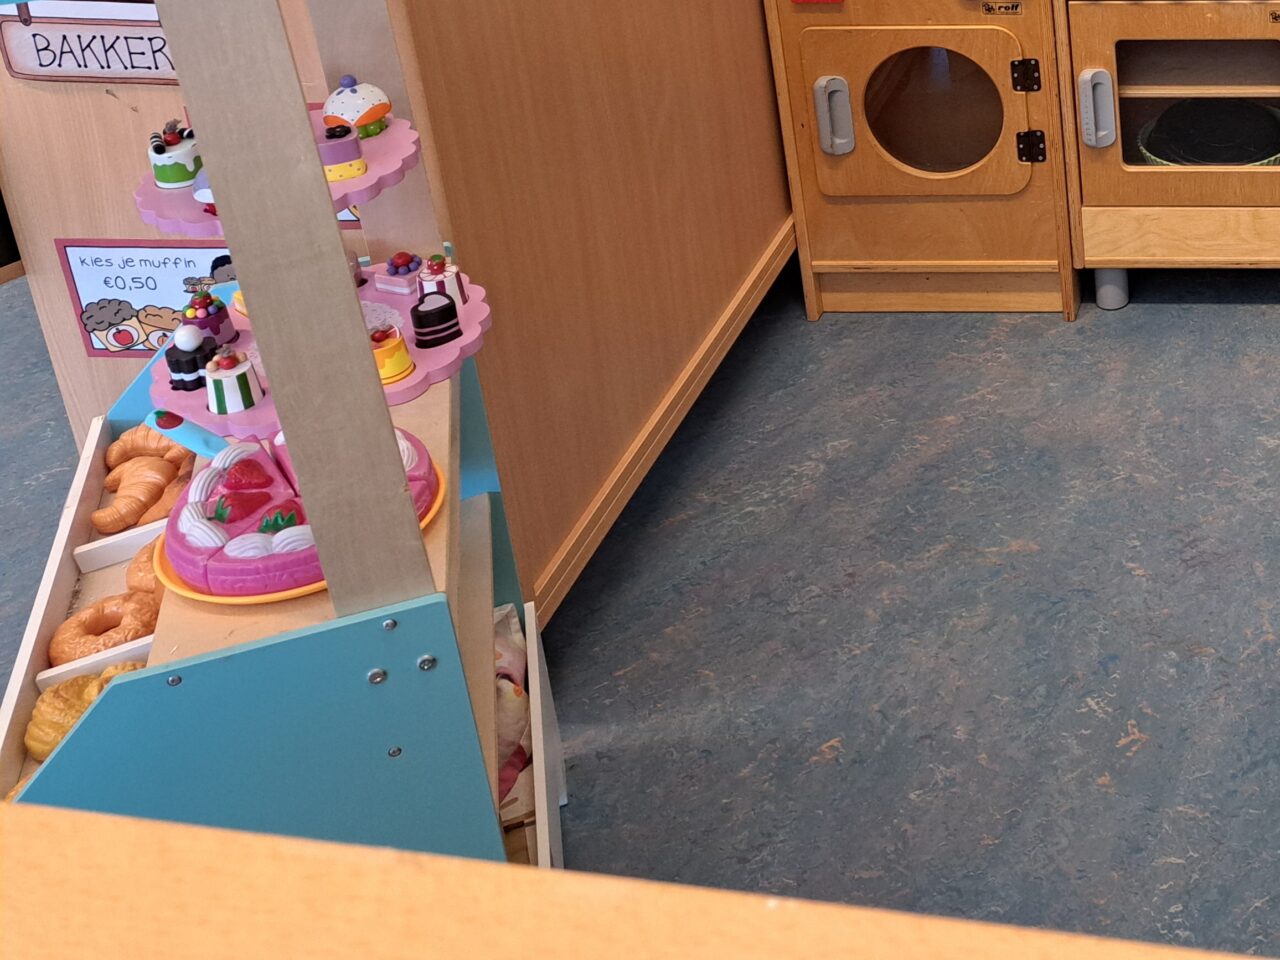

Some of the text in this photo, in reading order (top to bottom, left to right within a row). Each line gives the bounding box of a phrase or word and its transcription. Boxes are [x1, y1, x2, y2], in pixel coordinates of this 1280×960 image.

[998, 3, 1020, 12] rolf
[79, 255, 197, 270] kies je muffin
[103, 275, 158, 292] €0,50
